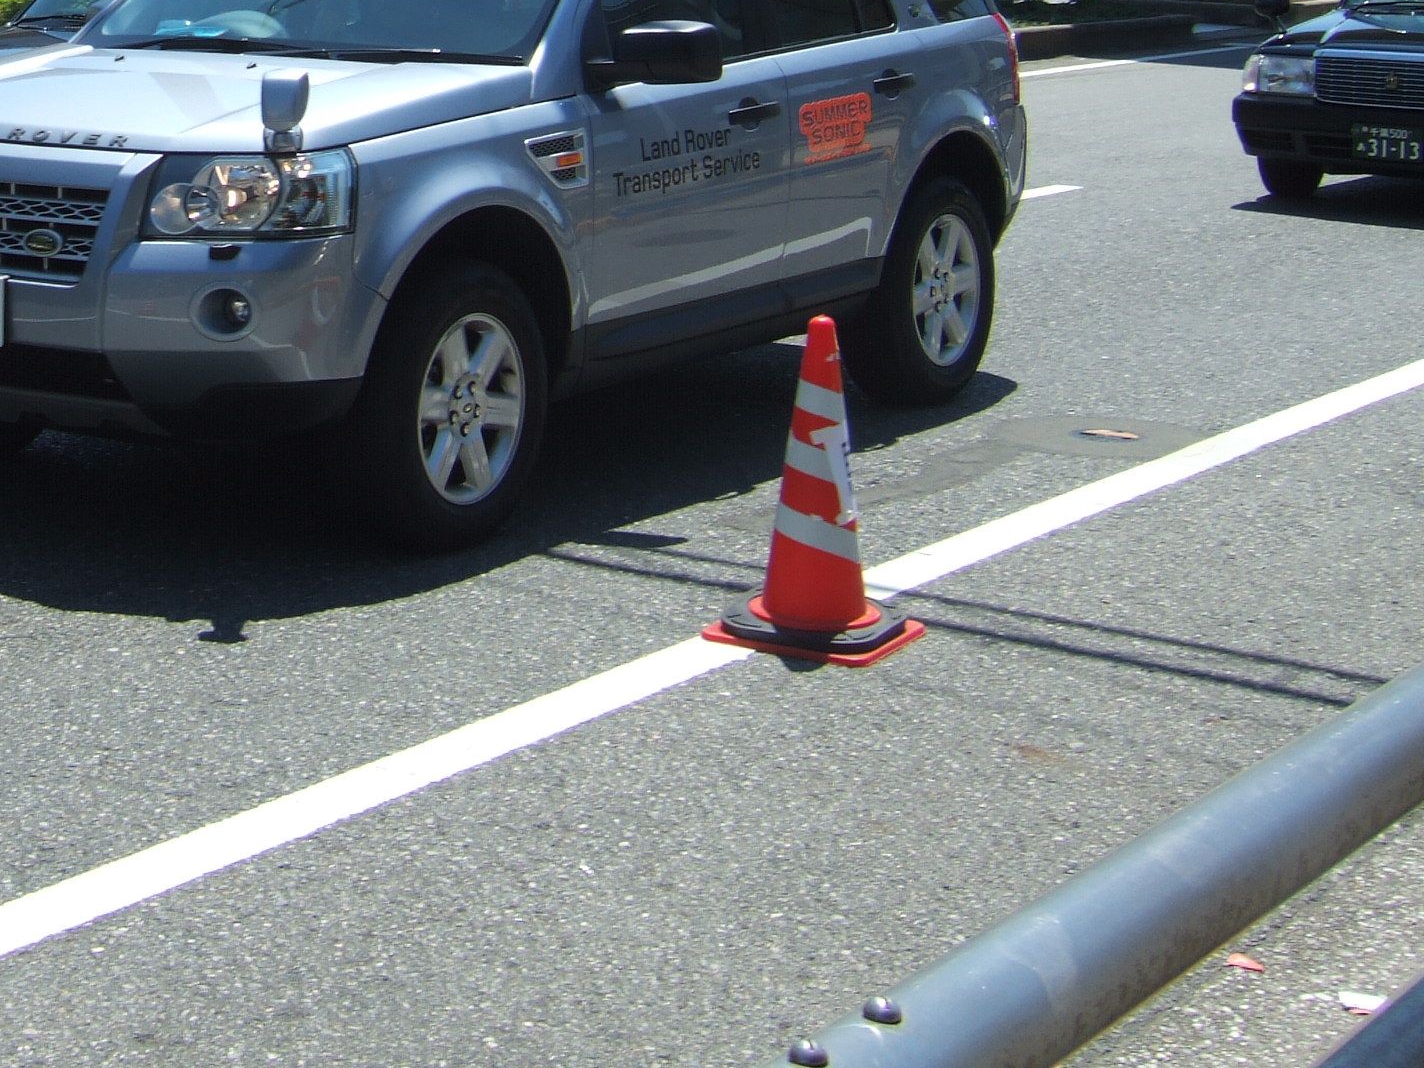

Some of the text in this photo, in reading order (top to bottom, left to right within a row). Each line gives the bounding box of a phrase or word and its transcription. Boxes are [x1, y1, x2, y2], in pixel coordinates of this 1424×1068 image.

[802, 99, 868, 126] SUMMER
[8, 126, 128, 148] ROVER
[640, 128, 731, 161] Land Rover
[812, 121, 861, 145] SONIC
[612, 149, 760, 196] Transport Service
